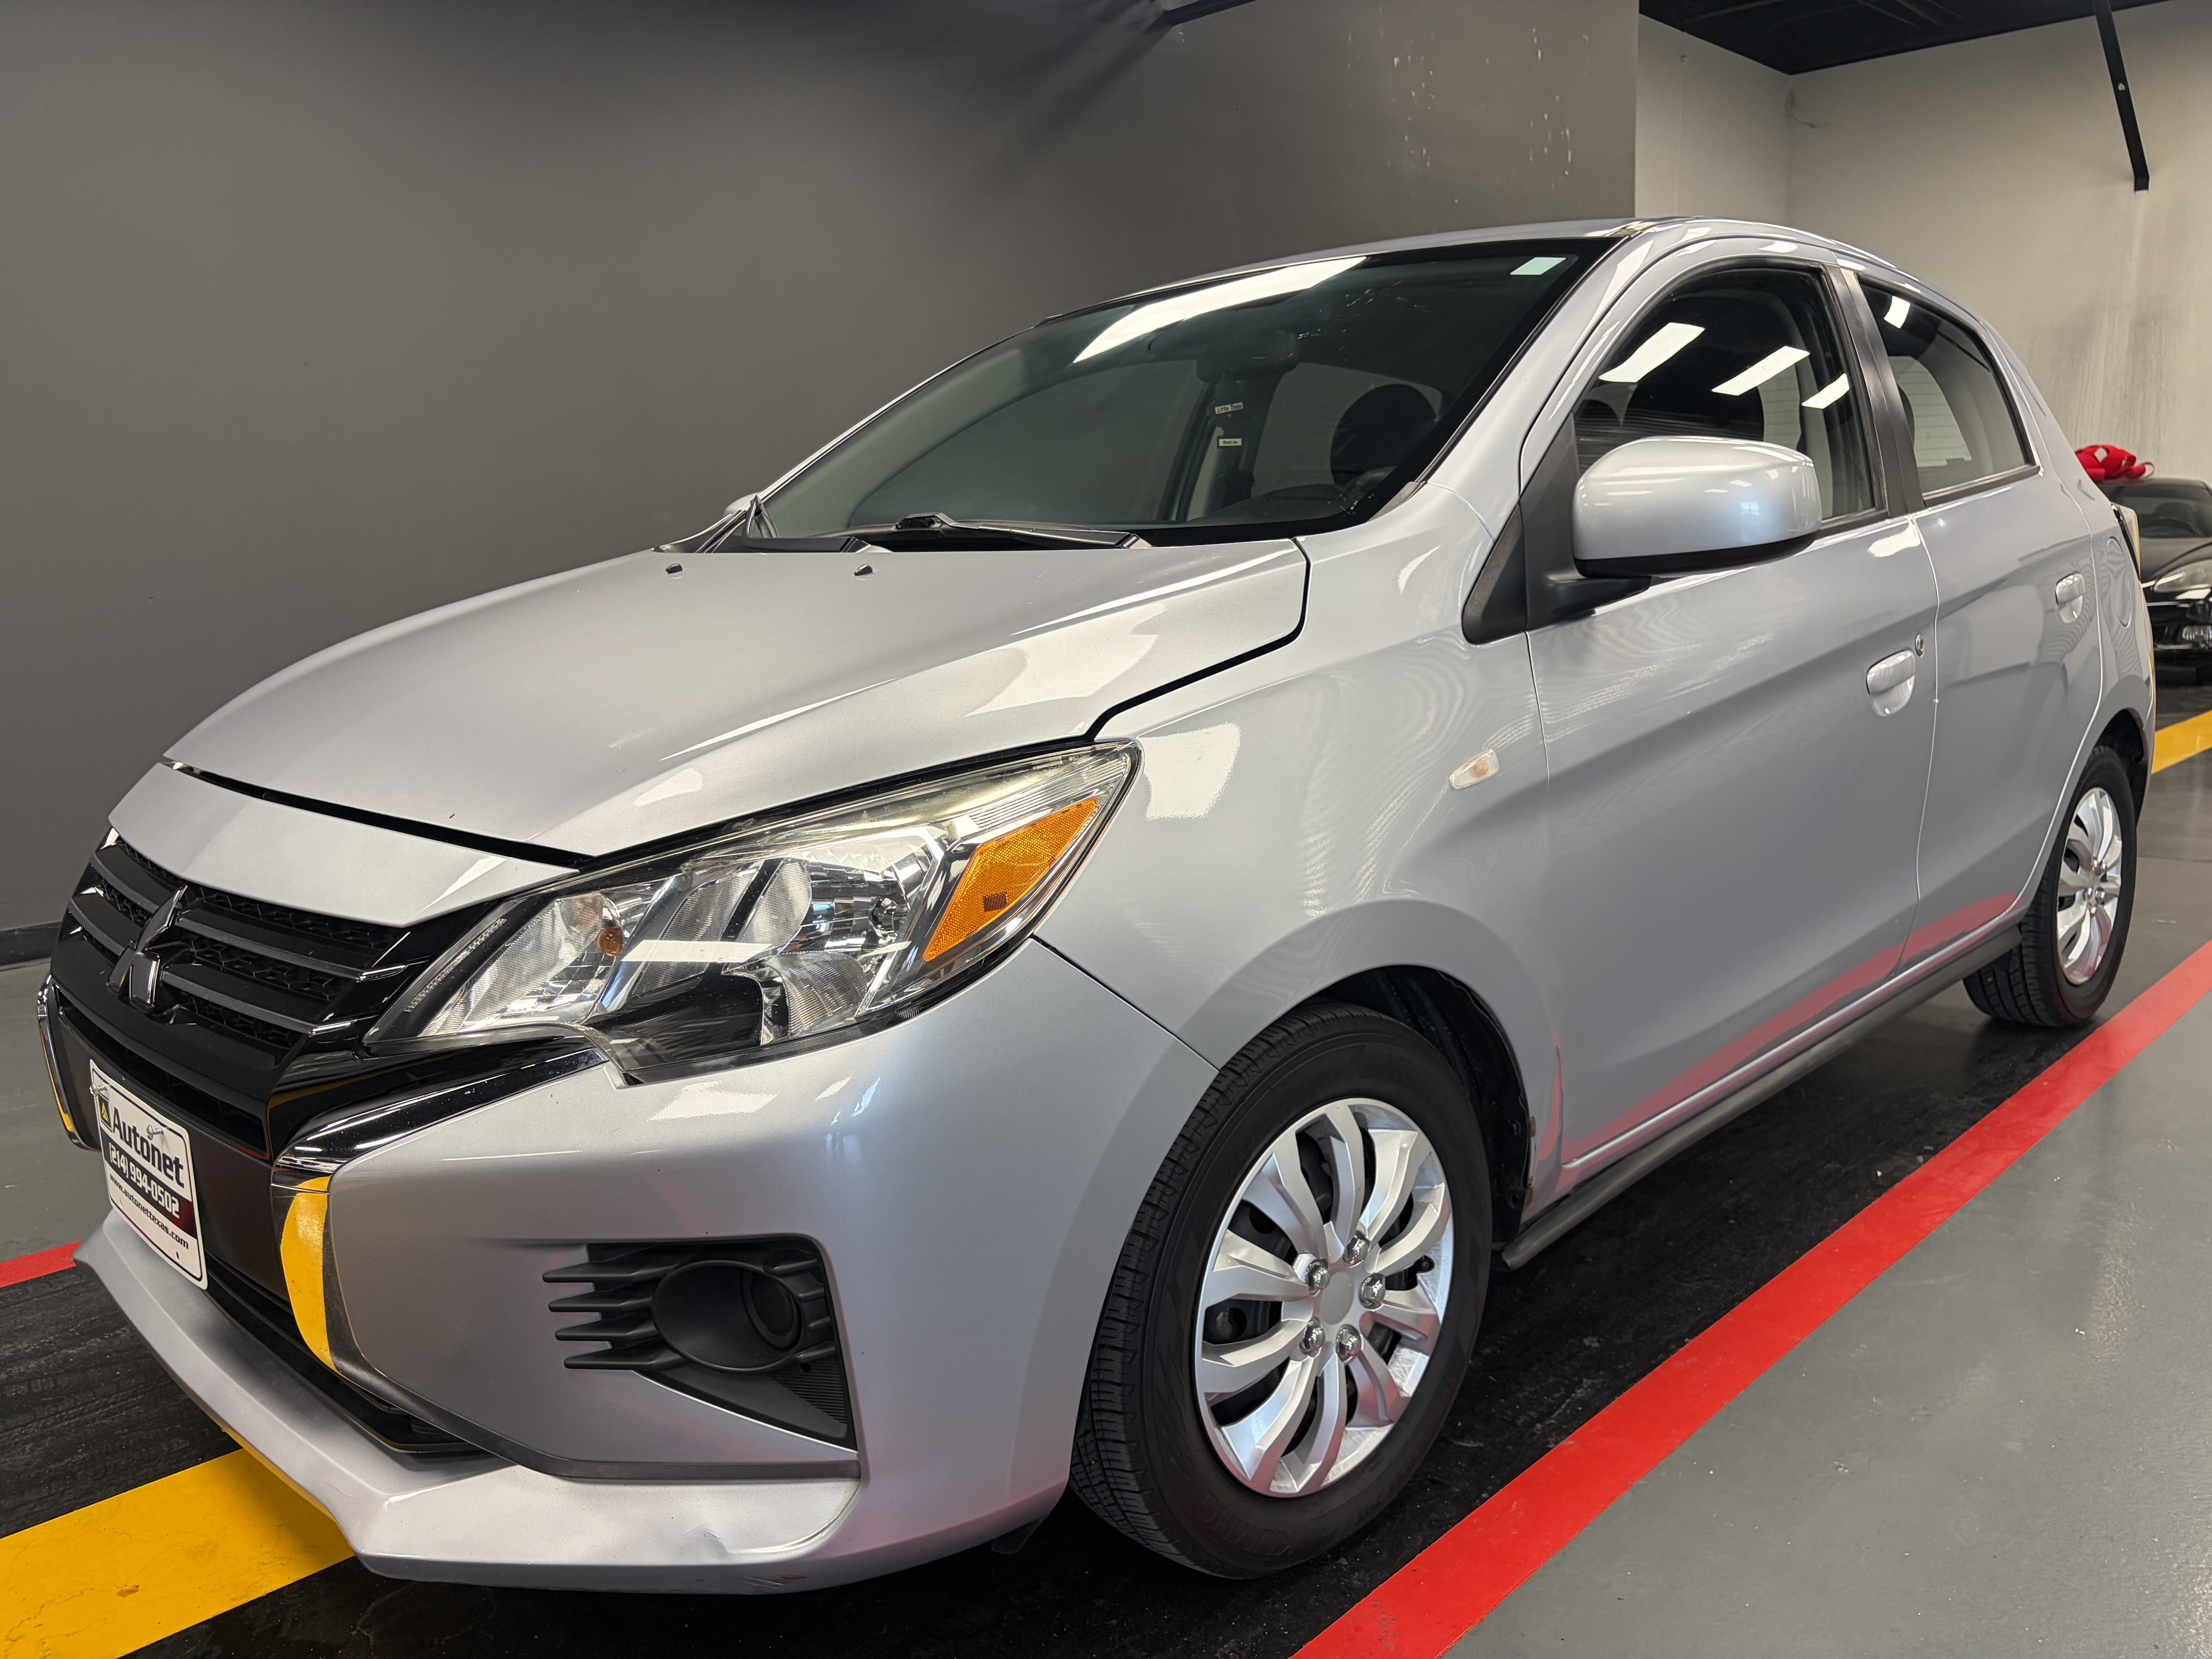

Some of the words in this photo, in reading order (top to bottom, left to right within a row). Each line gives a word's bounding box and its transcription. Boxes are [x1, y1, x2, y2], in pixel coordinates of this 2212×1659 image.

[109, 1142, 129, 1179] (214)
[130, 1161, 180, 1219] 994-0502
[113, 1106, 184, 1189] Autonet
[110, 1173, 189, 1250] www.autonettexas.com
